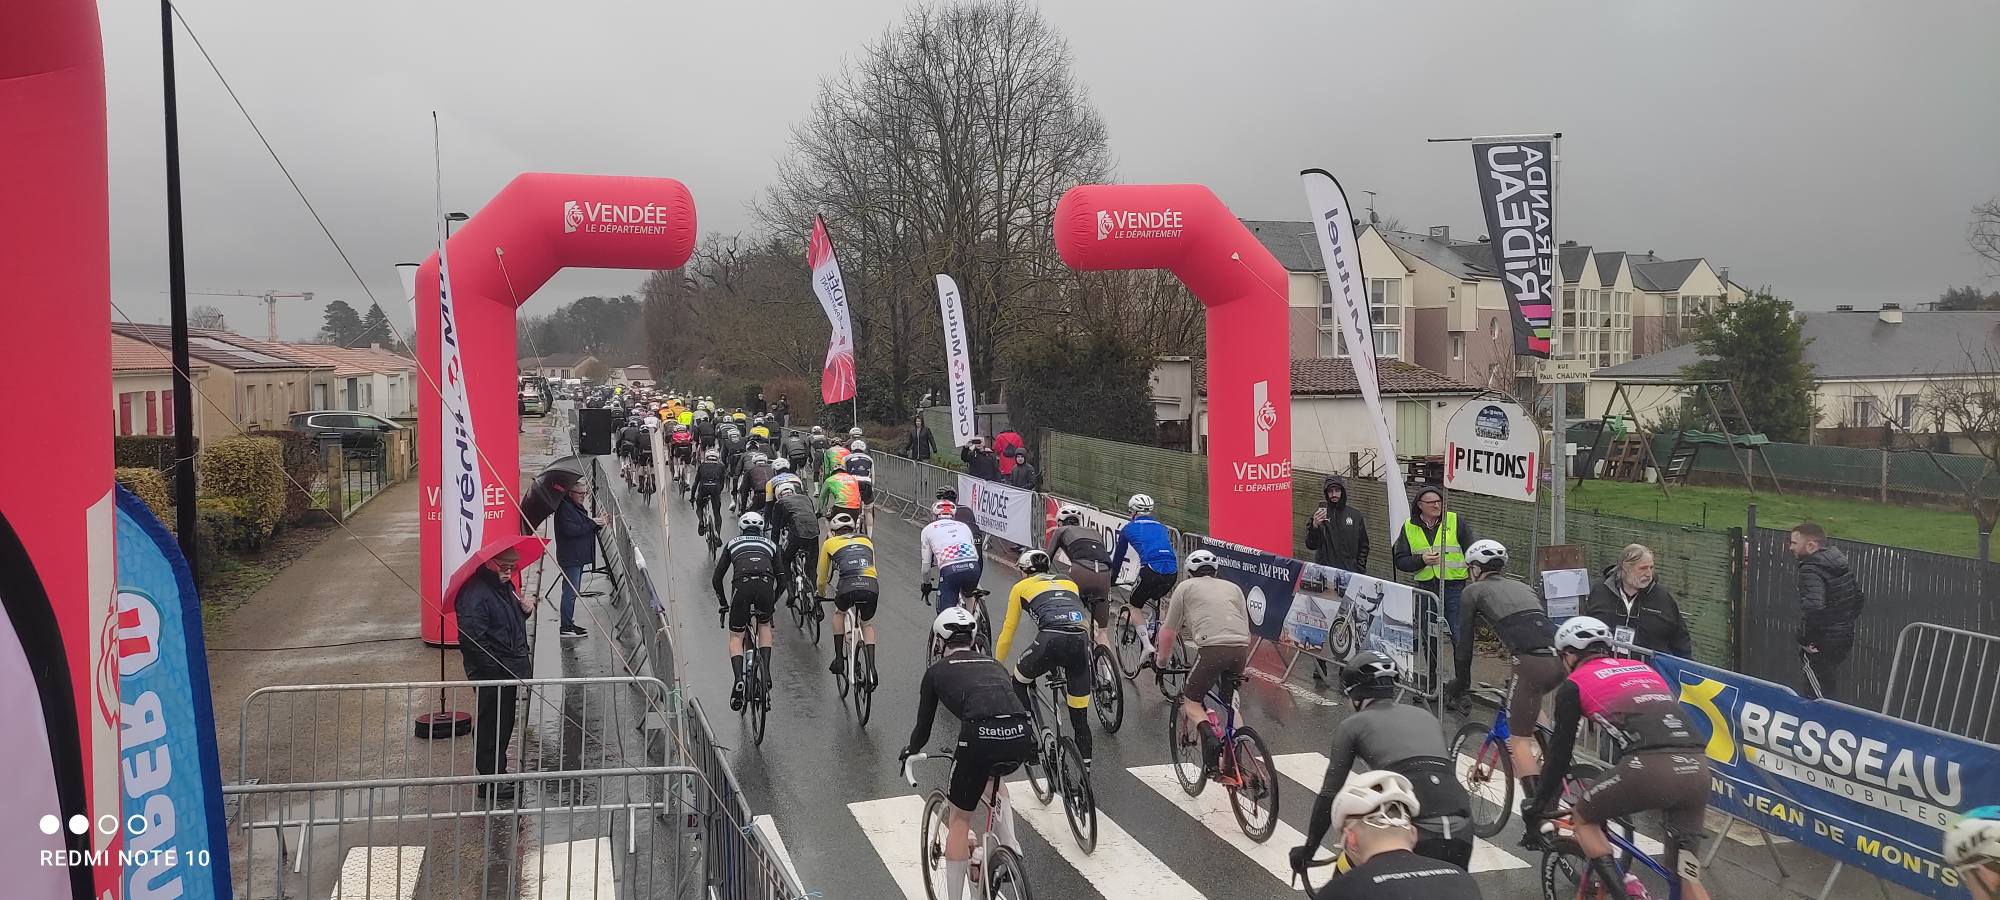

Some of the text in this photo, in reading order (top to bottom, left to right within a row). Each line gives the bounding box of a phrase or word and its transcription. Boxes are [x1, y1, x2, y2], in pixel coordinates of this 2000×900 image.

[584, 202, 667, 225] VENDÉE
[1113, 208, 1183, 229] VENDÉE
[585, 223, 667, 235] LE DÉPARTEMENT
[1115, 229, 1182, 239] LE DÉPARTEMENT
[1557, 372, 1588, 380] CHAUVIN
[1233, 458, 1291, 480] VENDÉE
[1455, 446, 1527, 479] PIETONS
[427, 484, 506, 507] VÉE
[1234, 484, 1243, 492] LE
[978, 484, 1009, 519] VENDÉE
[1082, 513, 1121, 554] VENDÉ
[1226, 542, 1233, 550] et
[1217, 555, 1241, 569] assions
[1242, 561, 1258, 573] avec
[978, 727, 1018, 737] Station
[1740, 701, 1962, 807] BESSEAU
[1758, 752, 1947, 825] AUTOMOBILES
[1743, 791, 1804, 827] JEAN
[1814, 818, 1845, 845] DE
[1856, 834, 1960, 888] MONTS
